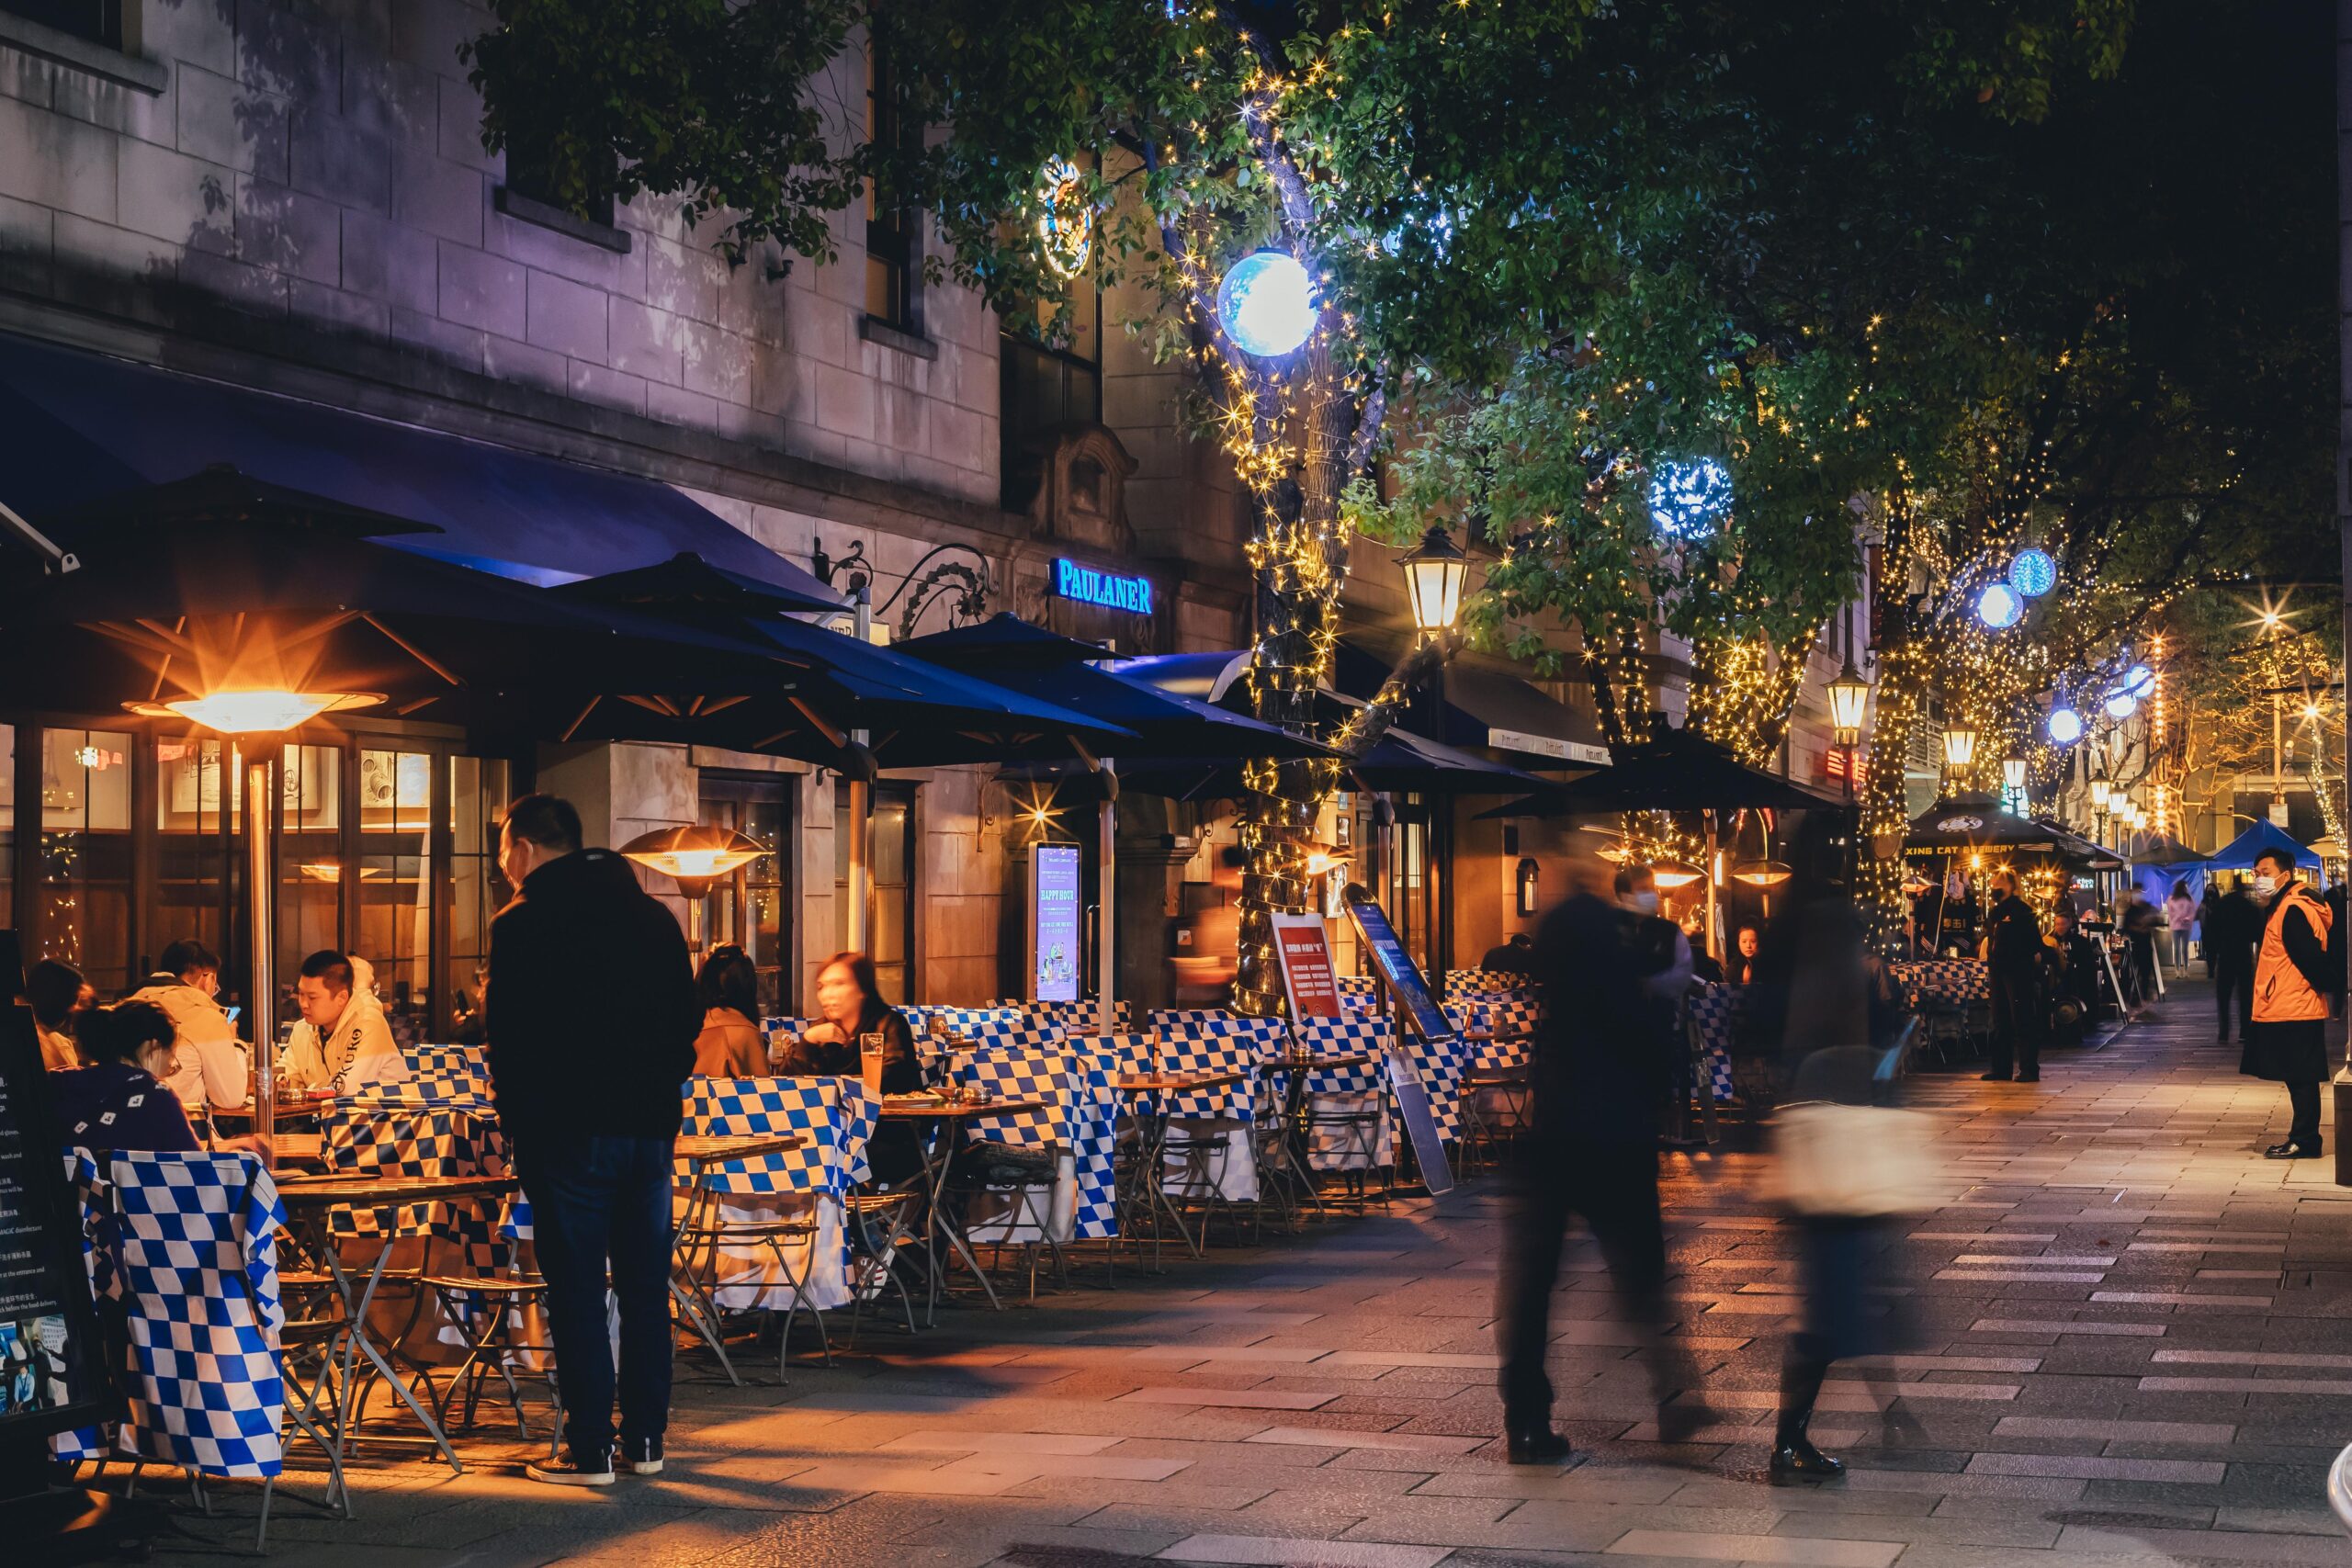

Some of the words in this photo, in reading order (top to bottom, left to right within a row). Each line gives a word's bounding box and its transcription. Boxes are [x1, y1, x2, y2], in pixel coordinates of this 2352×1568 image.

[1058, 559, 1152, 615] PAULANER
[1905, 847, 1933, 855] XING
[1937, 846, 1959, 854] CAT
[1962, 844, 2016, 854] BREWERY
[1041, 890, 1059, 900] HAPPY
[1059, 890, 1074, 900] HOUR
